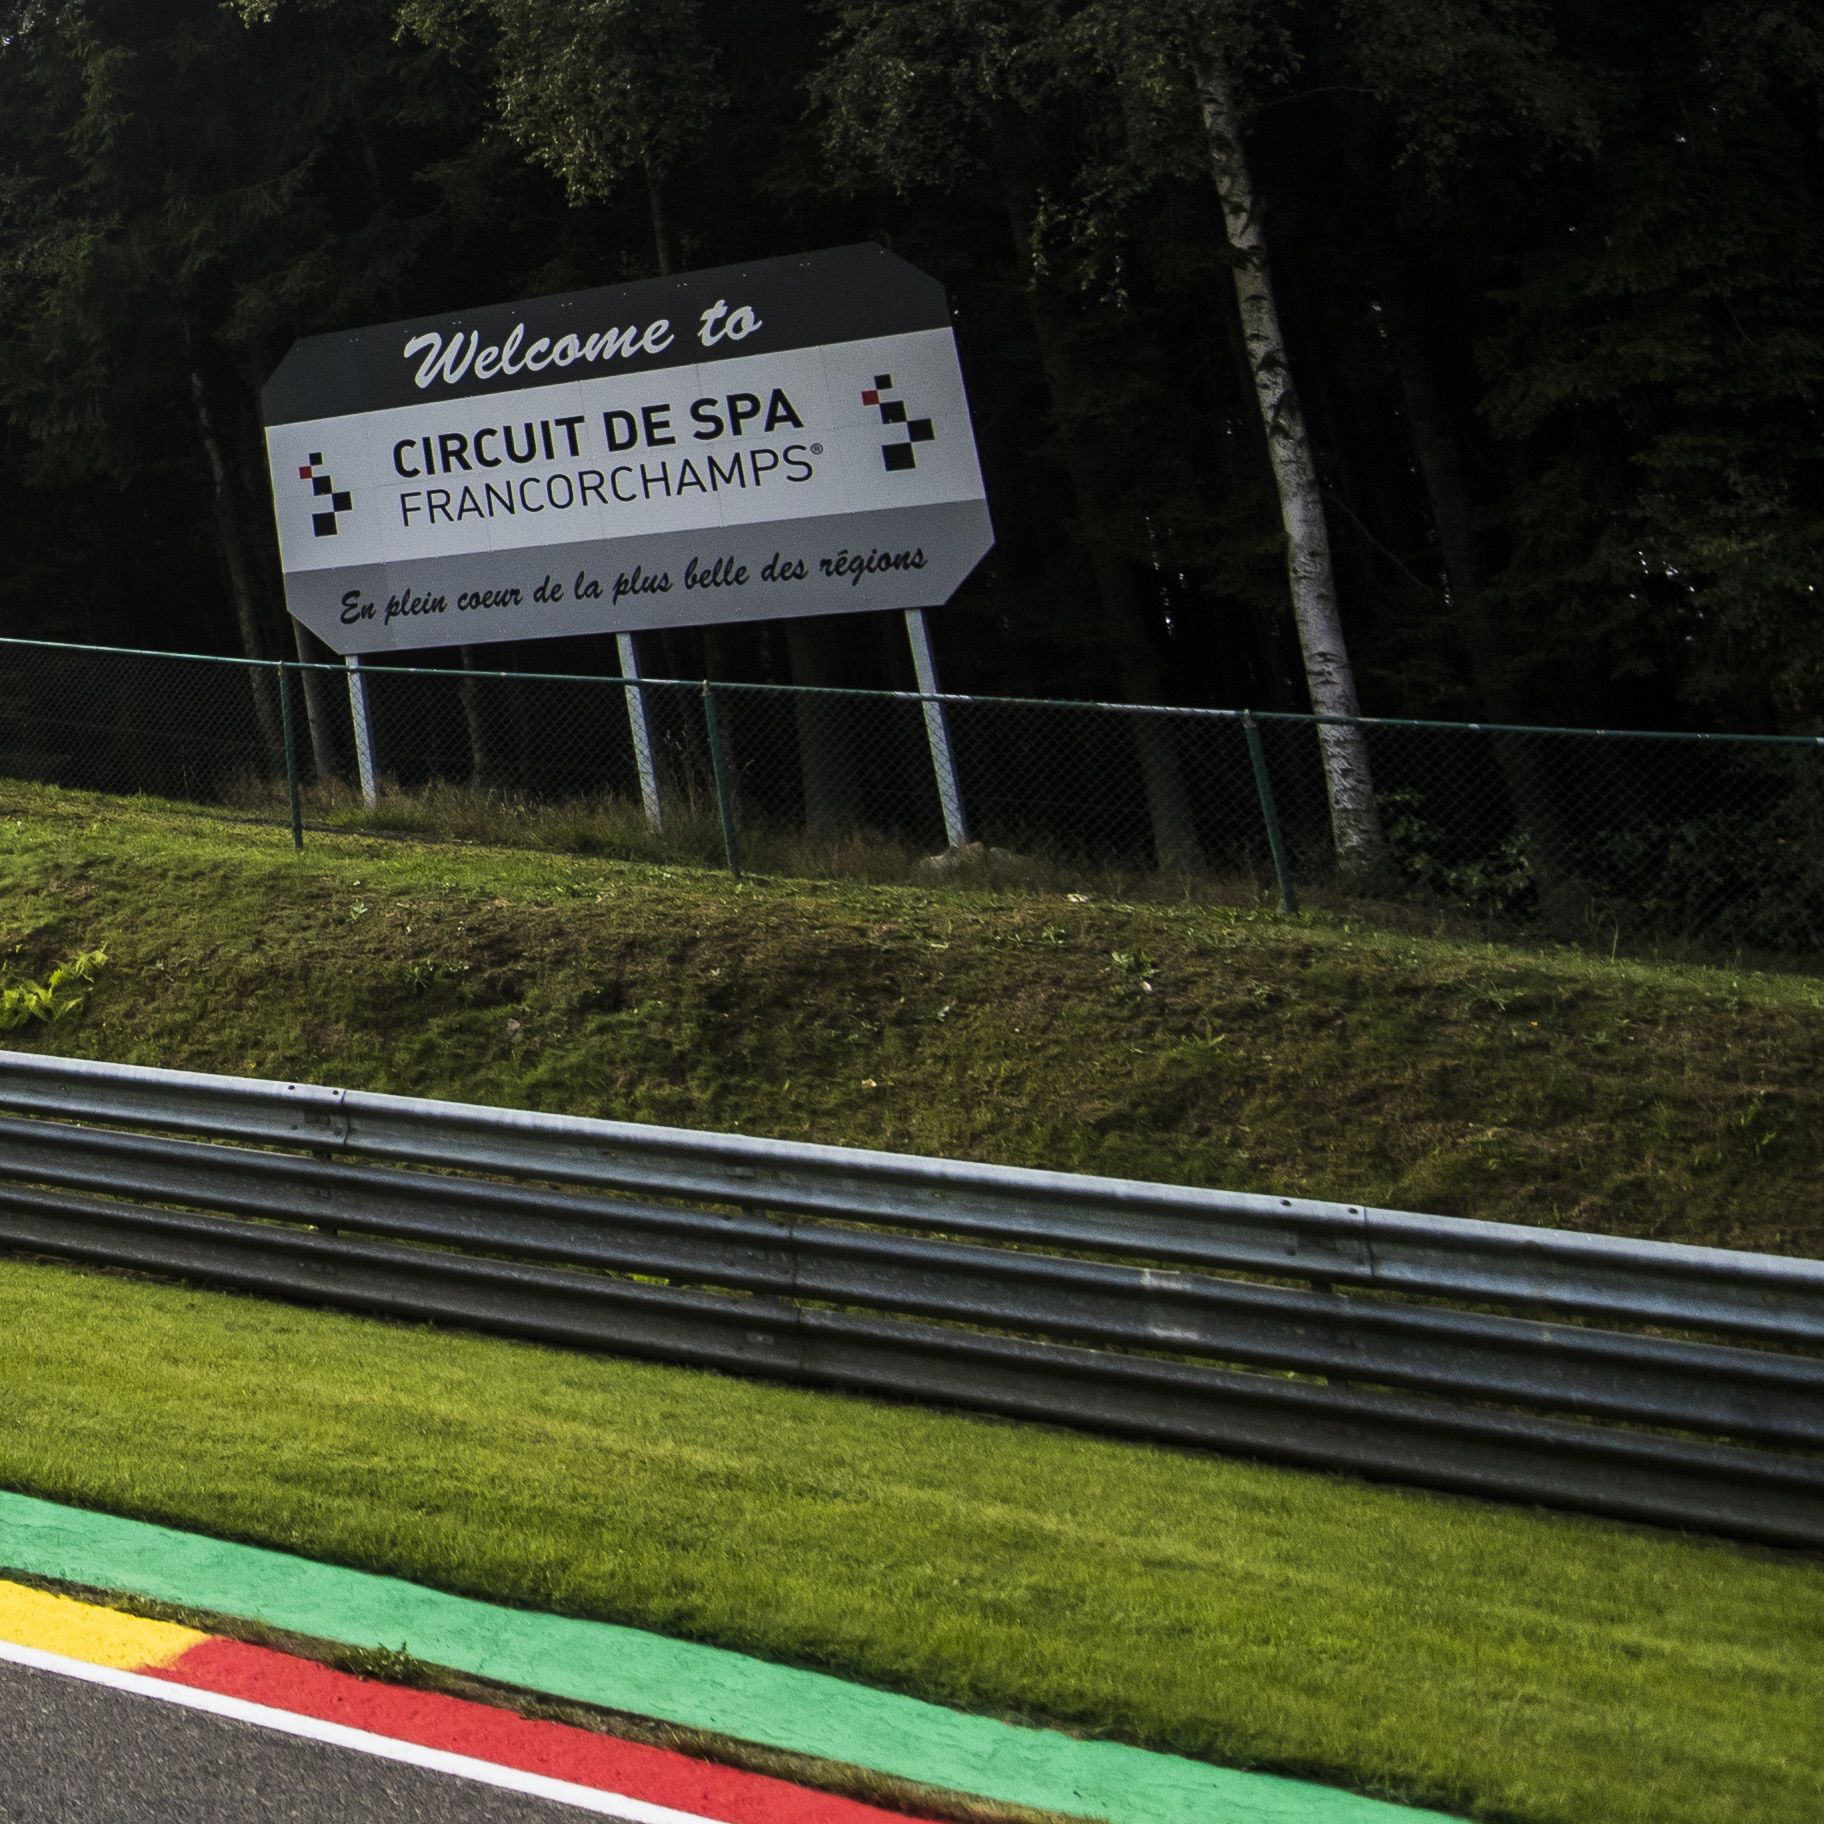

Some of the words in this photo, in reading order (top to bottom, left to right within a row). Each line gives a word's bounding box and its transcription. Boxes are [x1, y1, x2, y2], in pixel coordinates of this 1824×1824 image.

[403, 319, 675, 389] Welcome
[697, 299, 762, 347] to
[393, 415, 586, 478] CIRCUIT
[603, 404, 677, 452] DE
[690, 388, 804, 441] SPA
[340, 589, 377, 625] En
[384, 587, 448, 626] plein
[457, 587, 523, 612] coeur
[533, 574, 565, 604] de
[574, 570, 604, 600] la
[612, 564, 674, 606] plus
[684, 555, 752, 590] belle
[761, 551, 809, 582] des
[819, 547, 929, 586] régions
